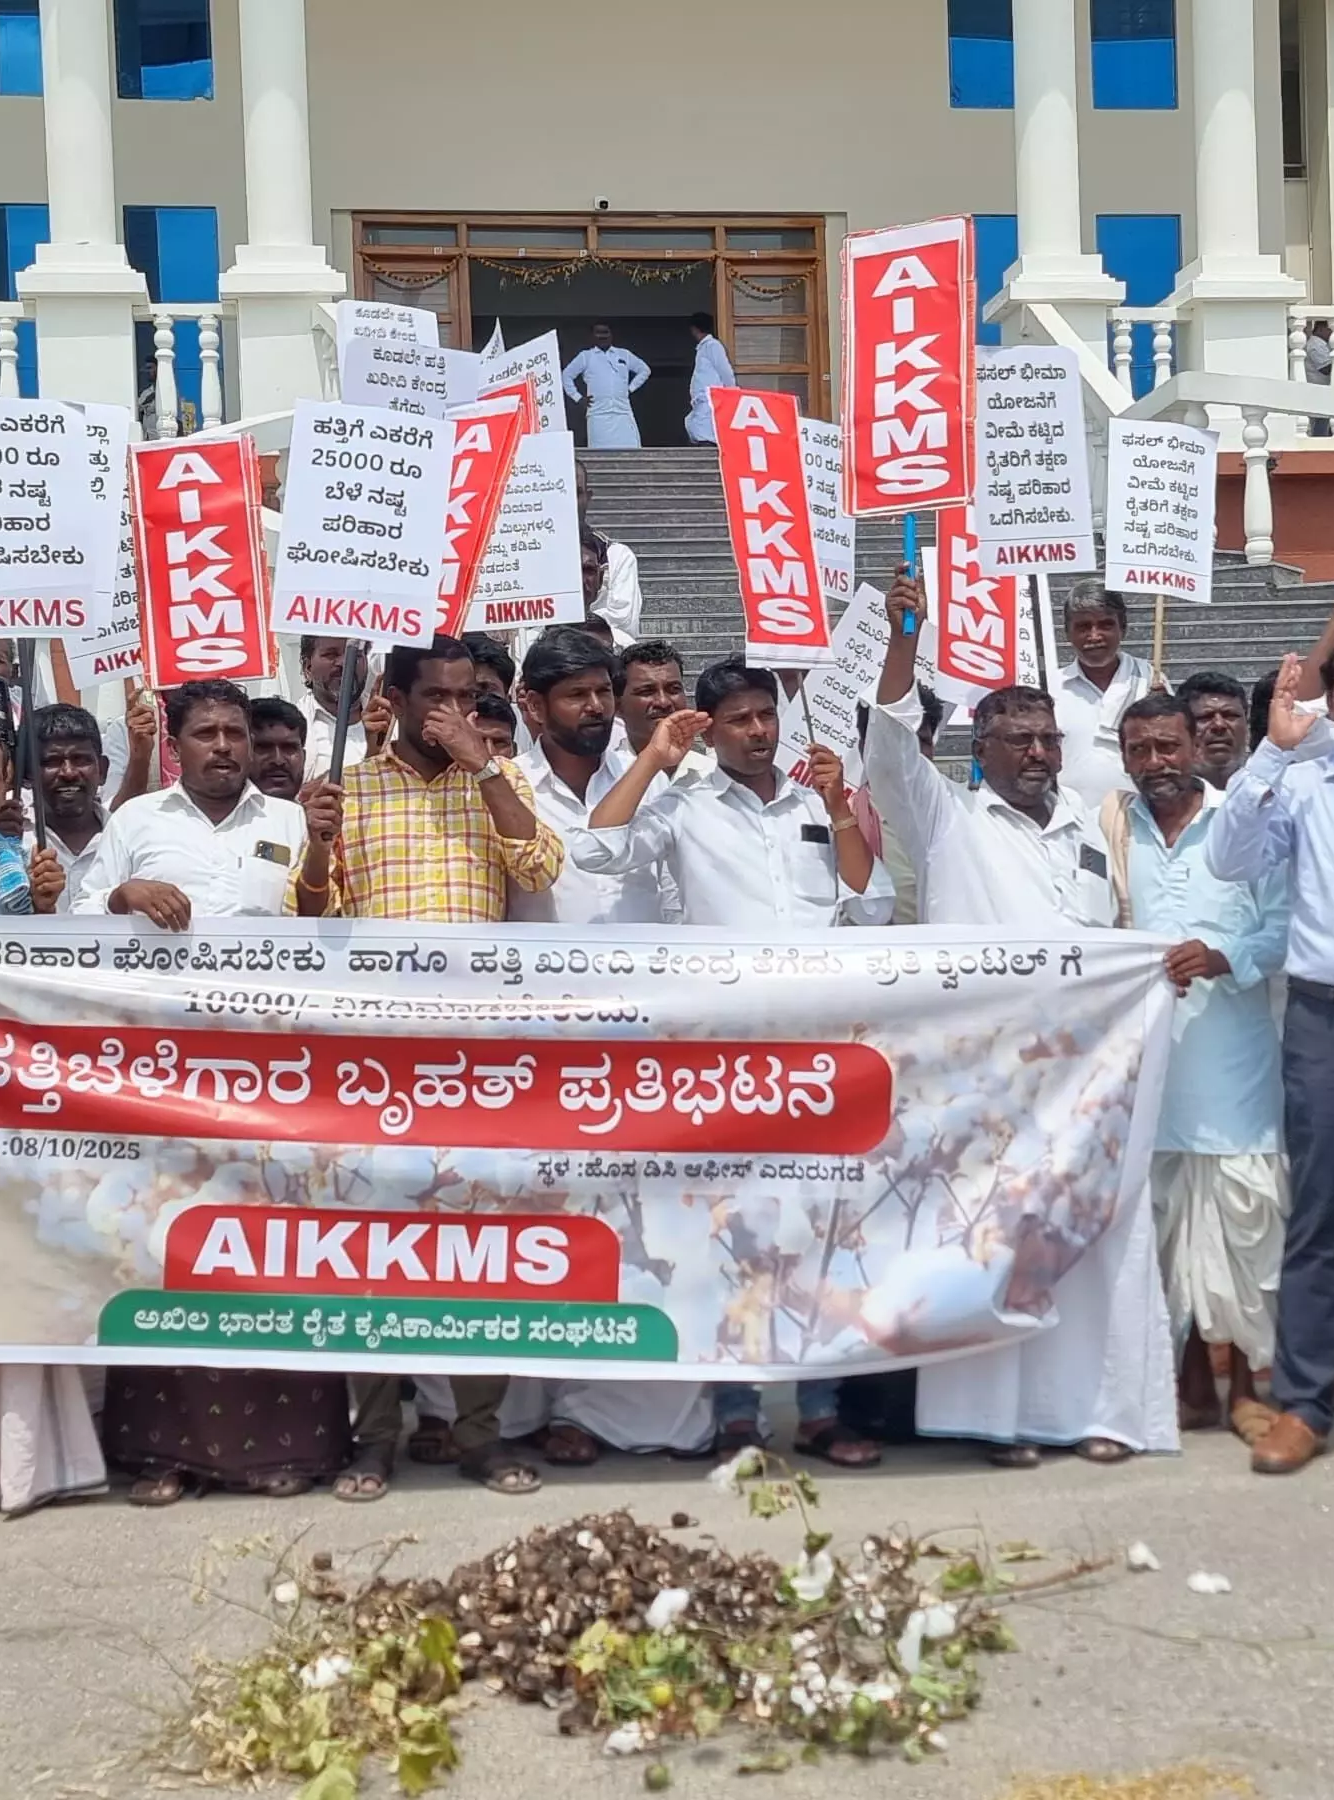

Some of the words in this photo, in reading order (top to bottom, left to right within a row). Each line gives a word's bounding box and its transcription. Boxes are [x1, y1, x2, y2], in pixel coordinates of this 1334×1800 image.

[871, 254, 950, 497] AIKKMS
[0, 414, 65, 434] ಎಕರೆಗೆ
[313, 417, 365, 444] ಹತ್ತಿಗೆ
[370, 425, 433, 450] ಎಕರೆಗೆ
[27, 449, 60, 466] ರೂ
[311, 448, 384, 472] 25000
[390, 457, 422, 480] ರೂ
[9, 480, 52, 507] ನಷ್ಟ
[325, 481, 363, 502] ಬೆಳೆ
[368, 487, 407, 517] ನಷ್ಟ
[1018, 478, 1071, 496] ಪರಿಹಾರ
[322, 514, 403, 540] ಪರಿಹಾರ
[730, 396, 815, 636] AIKKMS
[1155, 522, 1198, 541] ಪರಿಹಾರ
[157, 452, 248, 673] AIKKMS
[996, 542, 1077, 565] AIKKMS
[1125, 569, 1196, 592] AIKKMS
[286, 595, 422, 637] AIKKMS
[485, 598, 555, 625] AIKKMS
[112, 938, 327, 976] ಘೋಷಿಸಬೇಕು
[347, 941, 449, 975] ಹಾಗೂ
[470, 944, 525, 986] ಹತ್ತಿ
[534, 947, 635, 976] ಖರೀದಿ
[647, 946, 742, 985] ಕೇಂದ್ರ
[866, 947, 923, 985] ಪ್ರತಿ
[1059, 945, 1085, 978] ಗೆ
[335, 1050, 537, 1136] ಬೃಹತ್
[558, 1051, 838, 1136] ಪ್ರತಿಭಟನೆ
[191, 1216, 571, 1285] AIKKMS
[133, 1307, 210, 1335] ಅಖಿಲ
[218, 1310, 294, 1337] ಭಾರತ
[302, 1313, 345, 1348] ರೈತ
[527, 1316, 640, 1349] ಸಂಘಟನೆ
